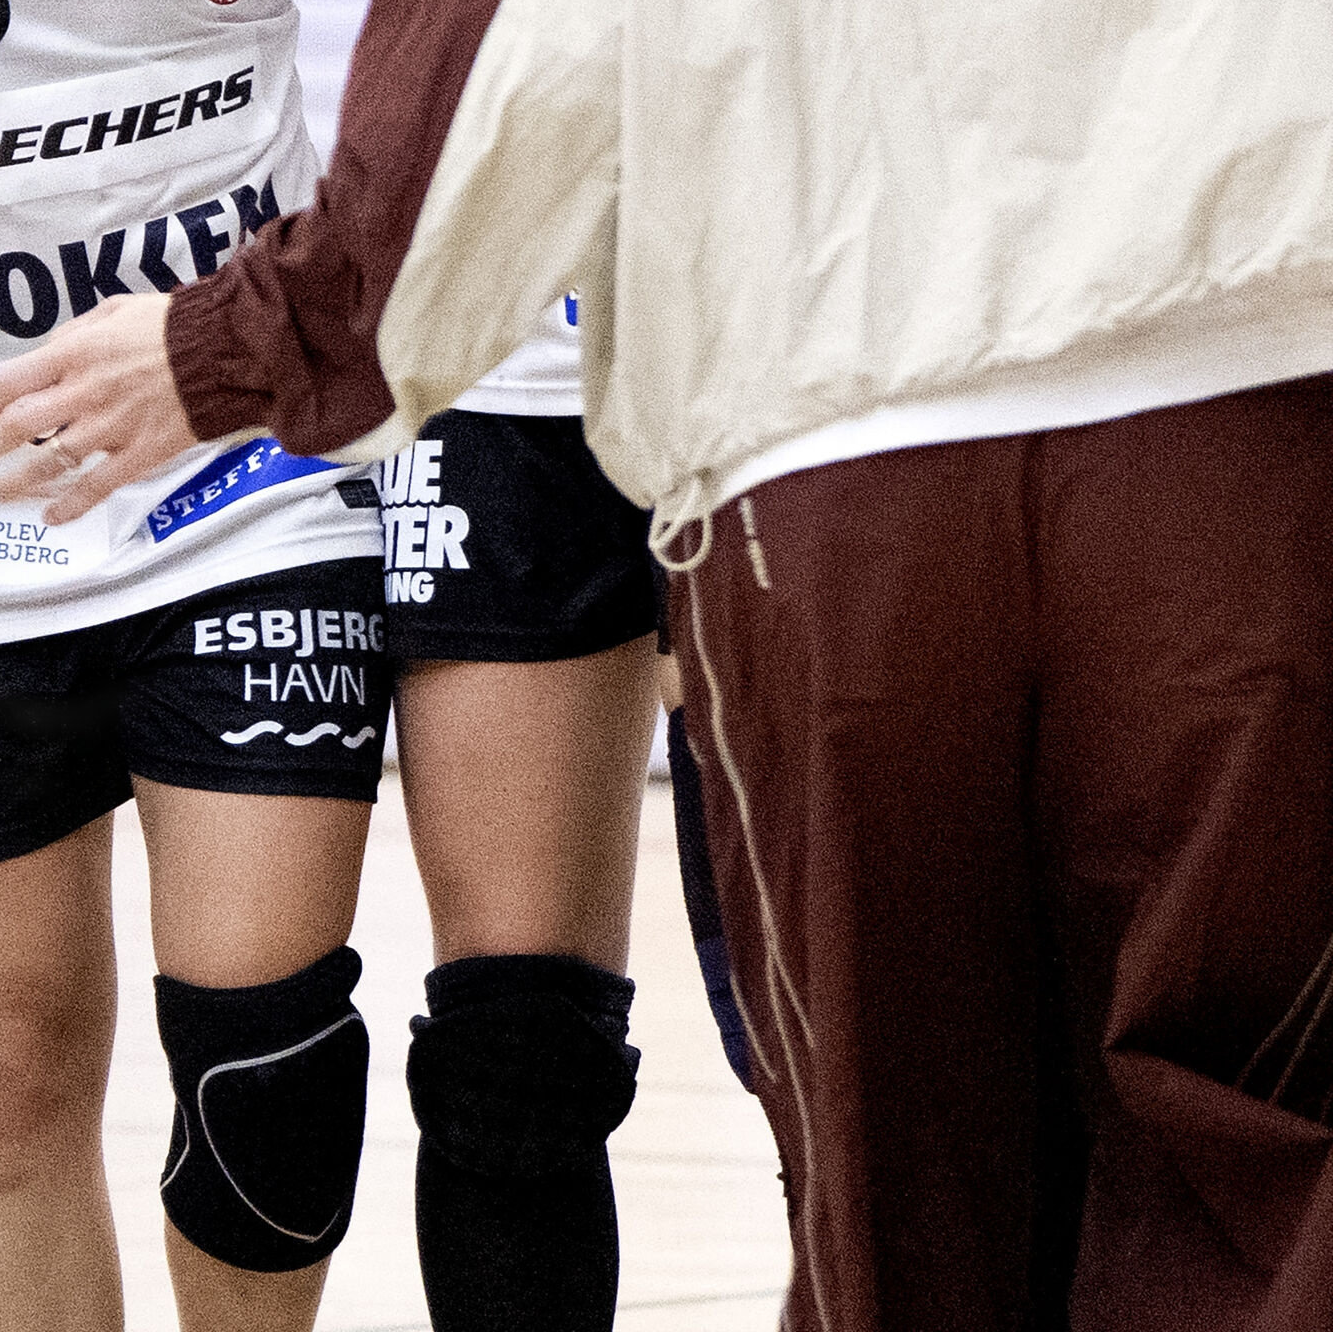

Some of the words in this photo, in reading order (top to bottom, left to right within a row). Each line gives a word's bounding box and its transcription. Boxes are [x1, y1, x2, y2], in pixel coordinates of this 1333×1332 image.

[150, 446, 283, 532] STEFF-
[384, 440, 443, 505] UE
[384, 504, 470, 571] TER
[194, 609, 384, 657] ESBJERG
[244, 663, 365, 705] HAVN
